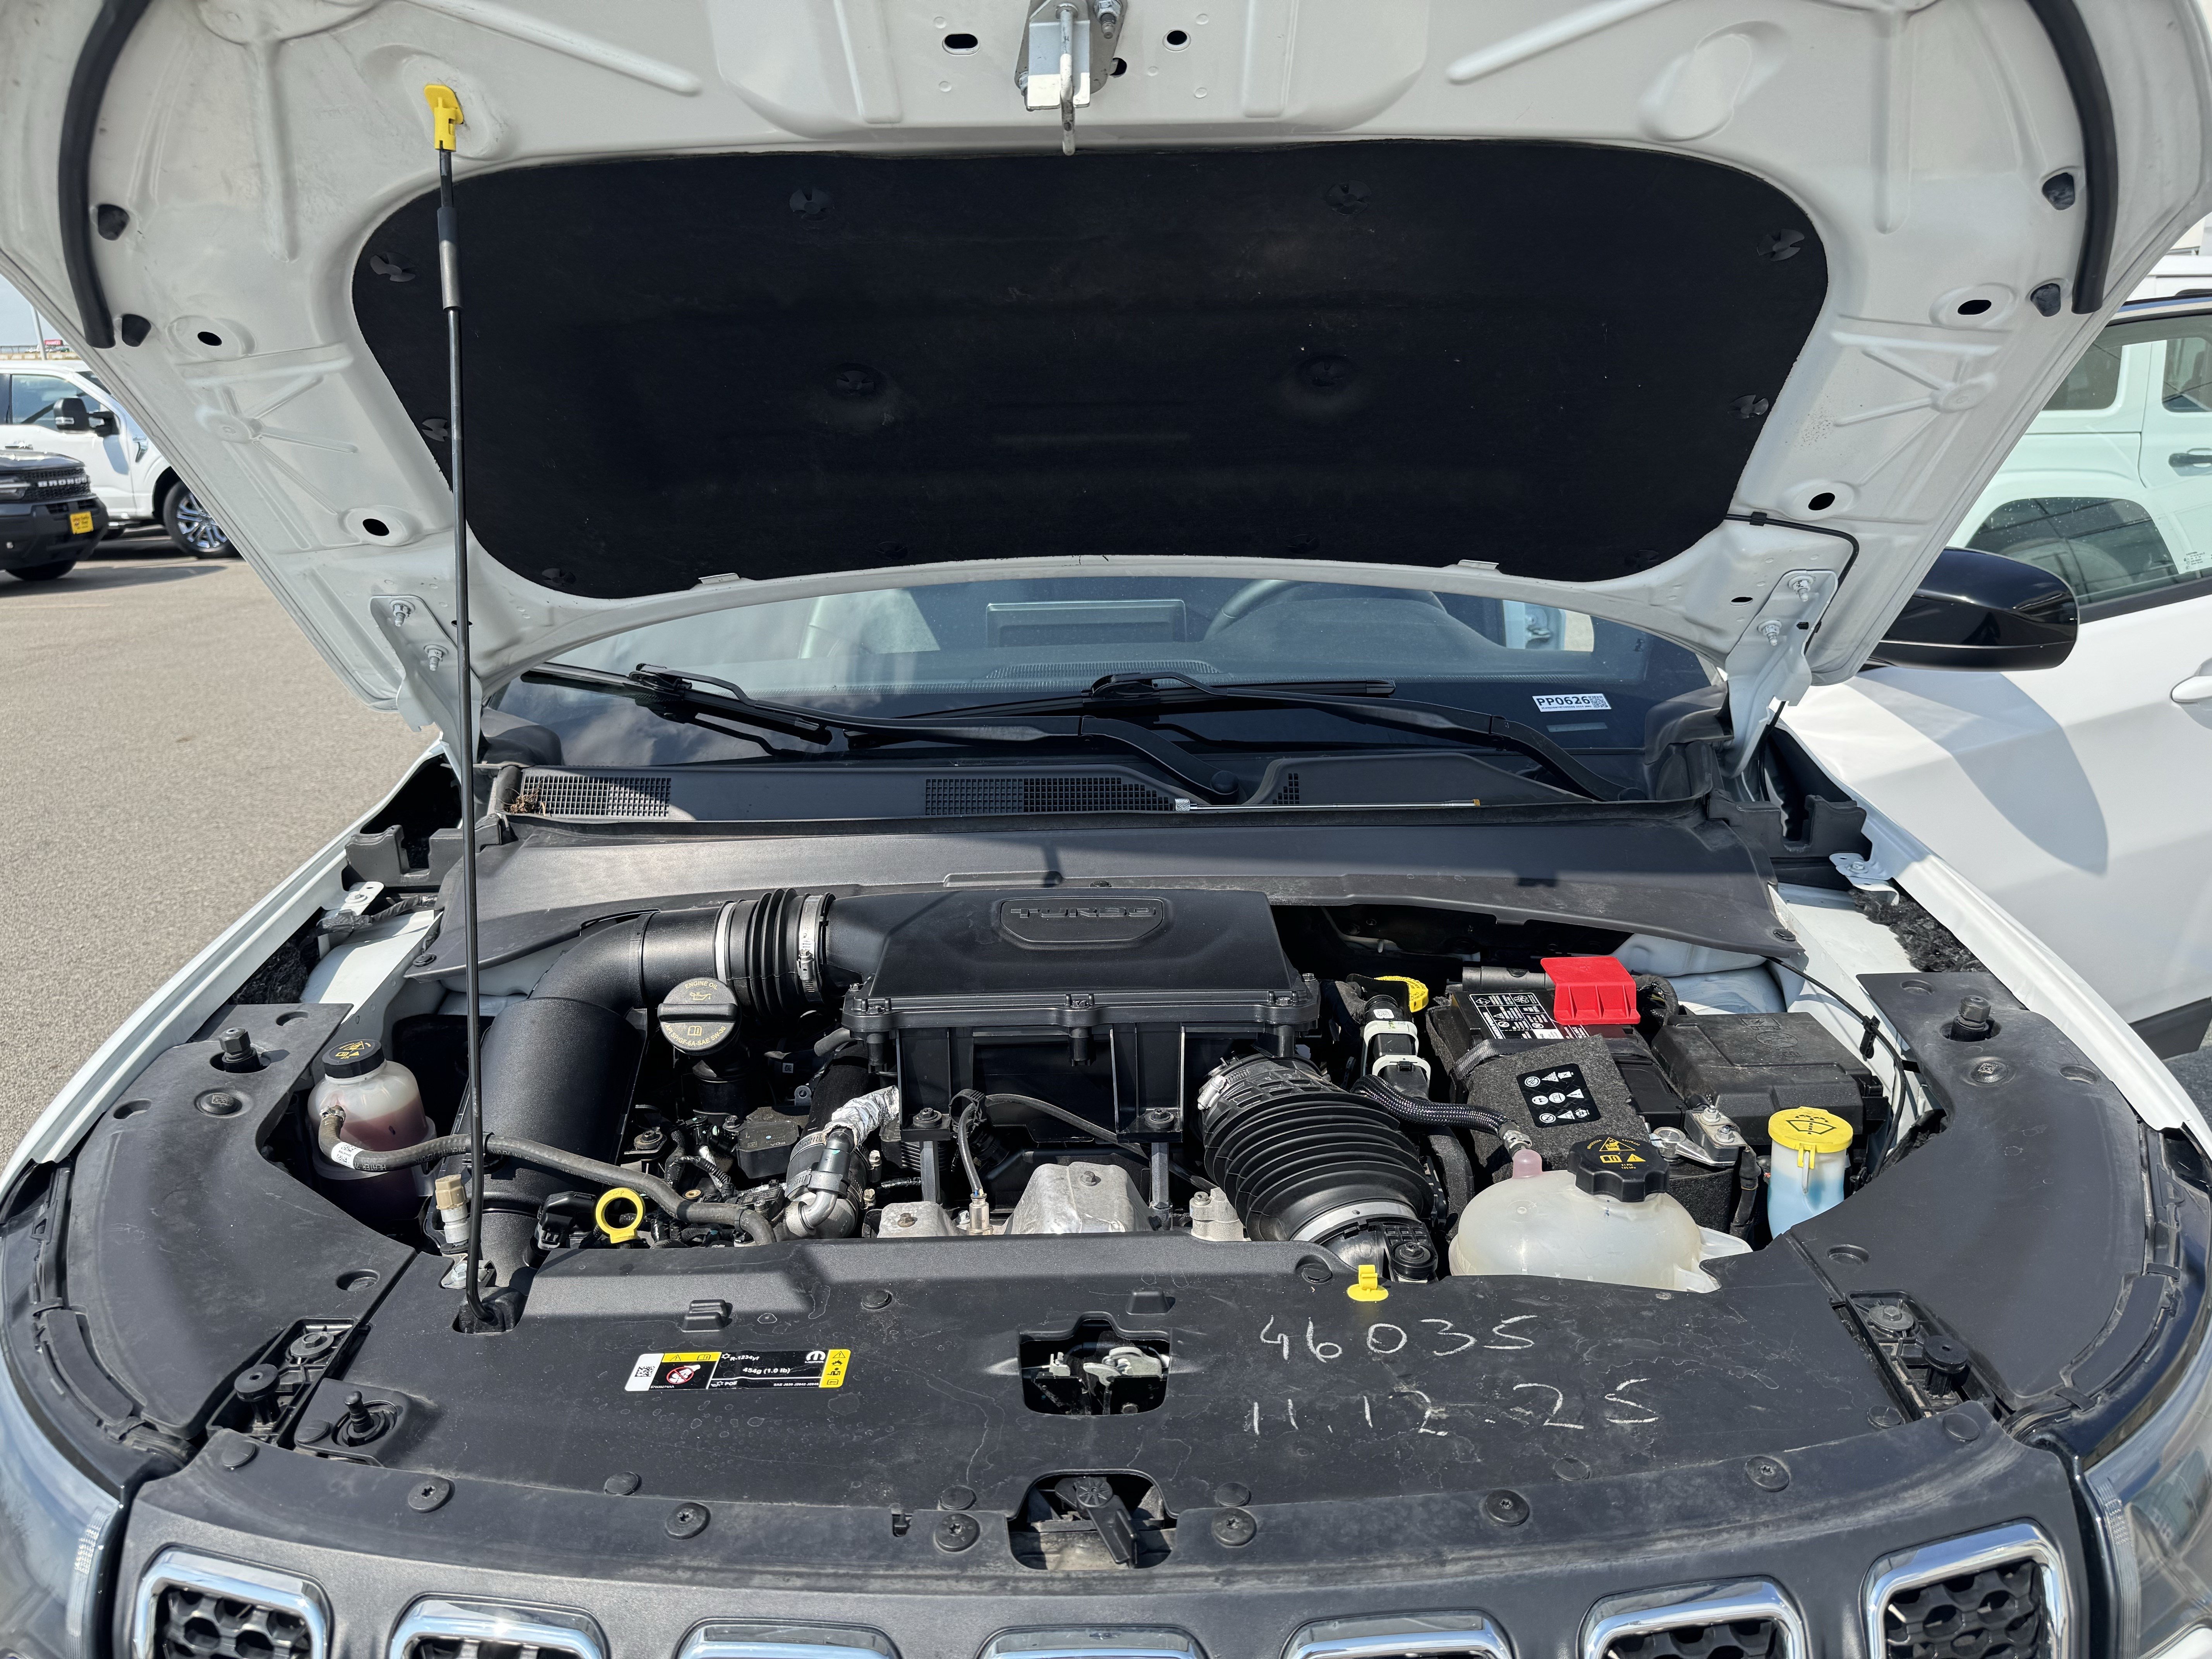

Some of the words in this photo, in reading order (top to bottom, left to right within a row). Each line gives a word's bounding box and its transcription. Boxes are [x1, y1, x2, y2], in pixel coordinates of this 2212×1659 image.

[1536, 696, 1590, 706] PP0626
[1010, 907, 1157, 918] TURBO
[684, 981, 709, 989] ENGINE
[709, 982, 718, 990] OIL
[711, 1025, 726, 1041] 5W-30
[1259, 1314, 1538, 1364] 46035
